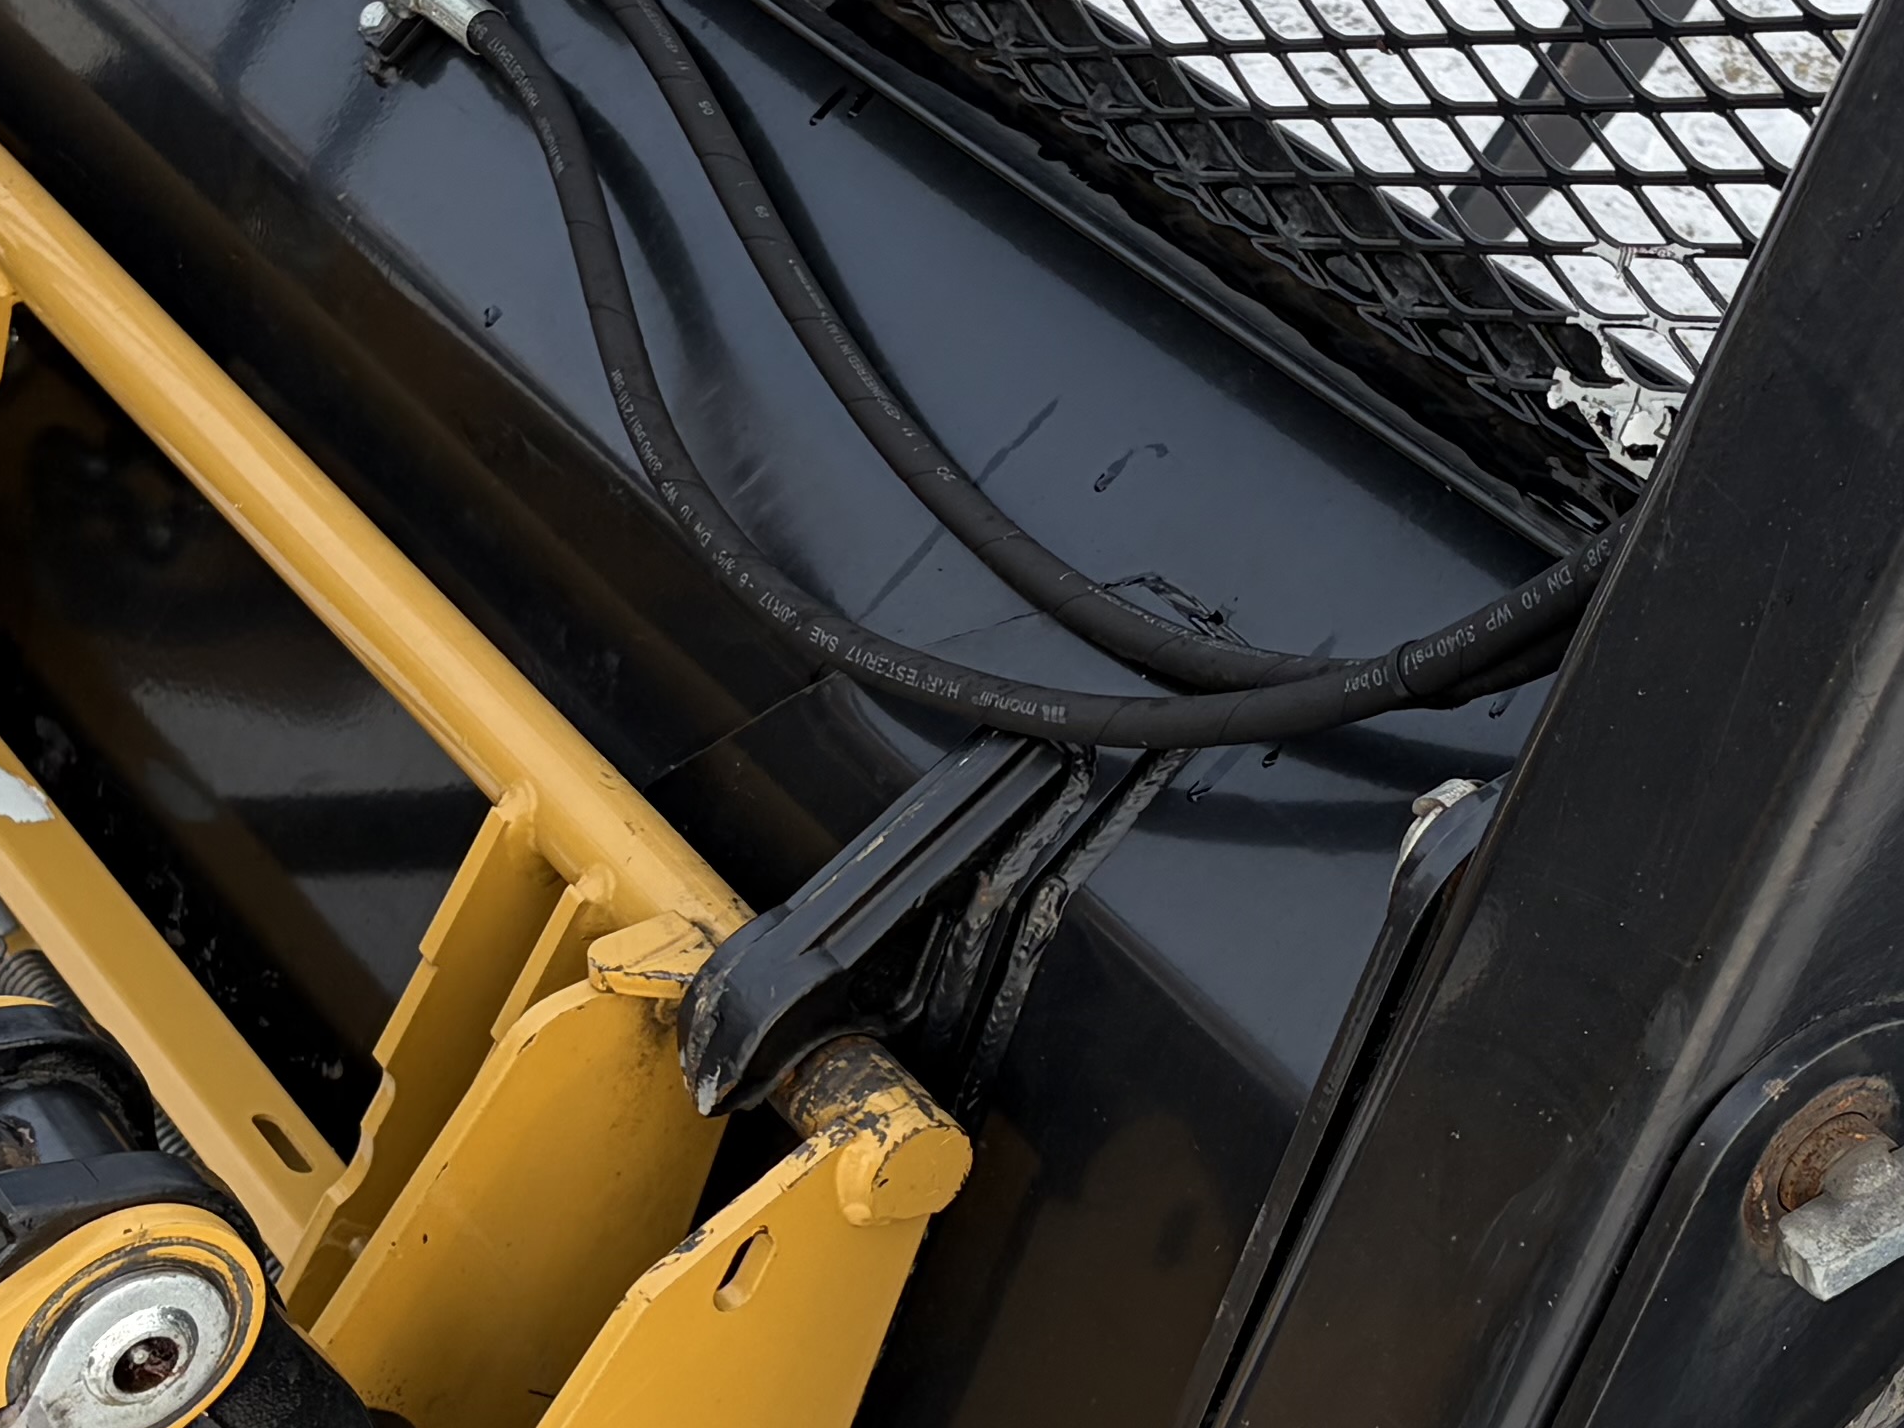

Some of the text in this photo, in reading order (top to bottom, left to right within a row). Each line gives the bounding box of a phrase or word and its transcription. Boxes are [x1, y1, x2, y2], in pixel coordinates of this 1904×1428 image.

[1545, 564, 1574, 594] DN
[1520, 586, 1542, 611] 10
[1484, 605, 1514, 632] WP
[806, 624, 841, 653] SAE
